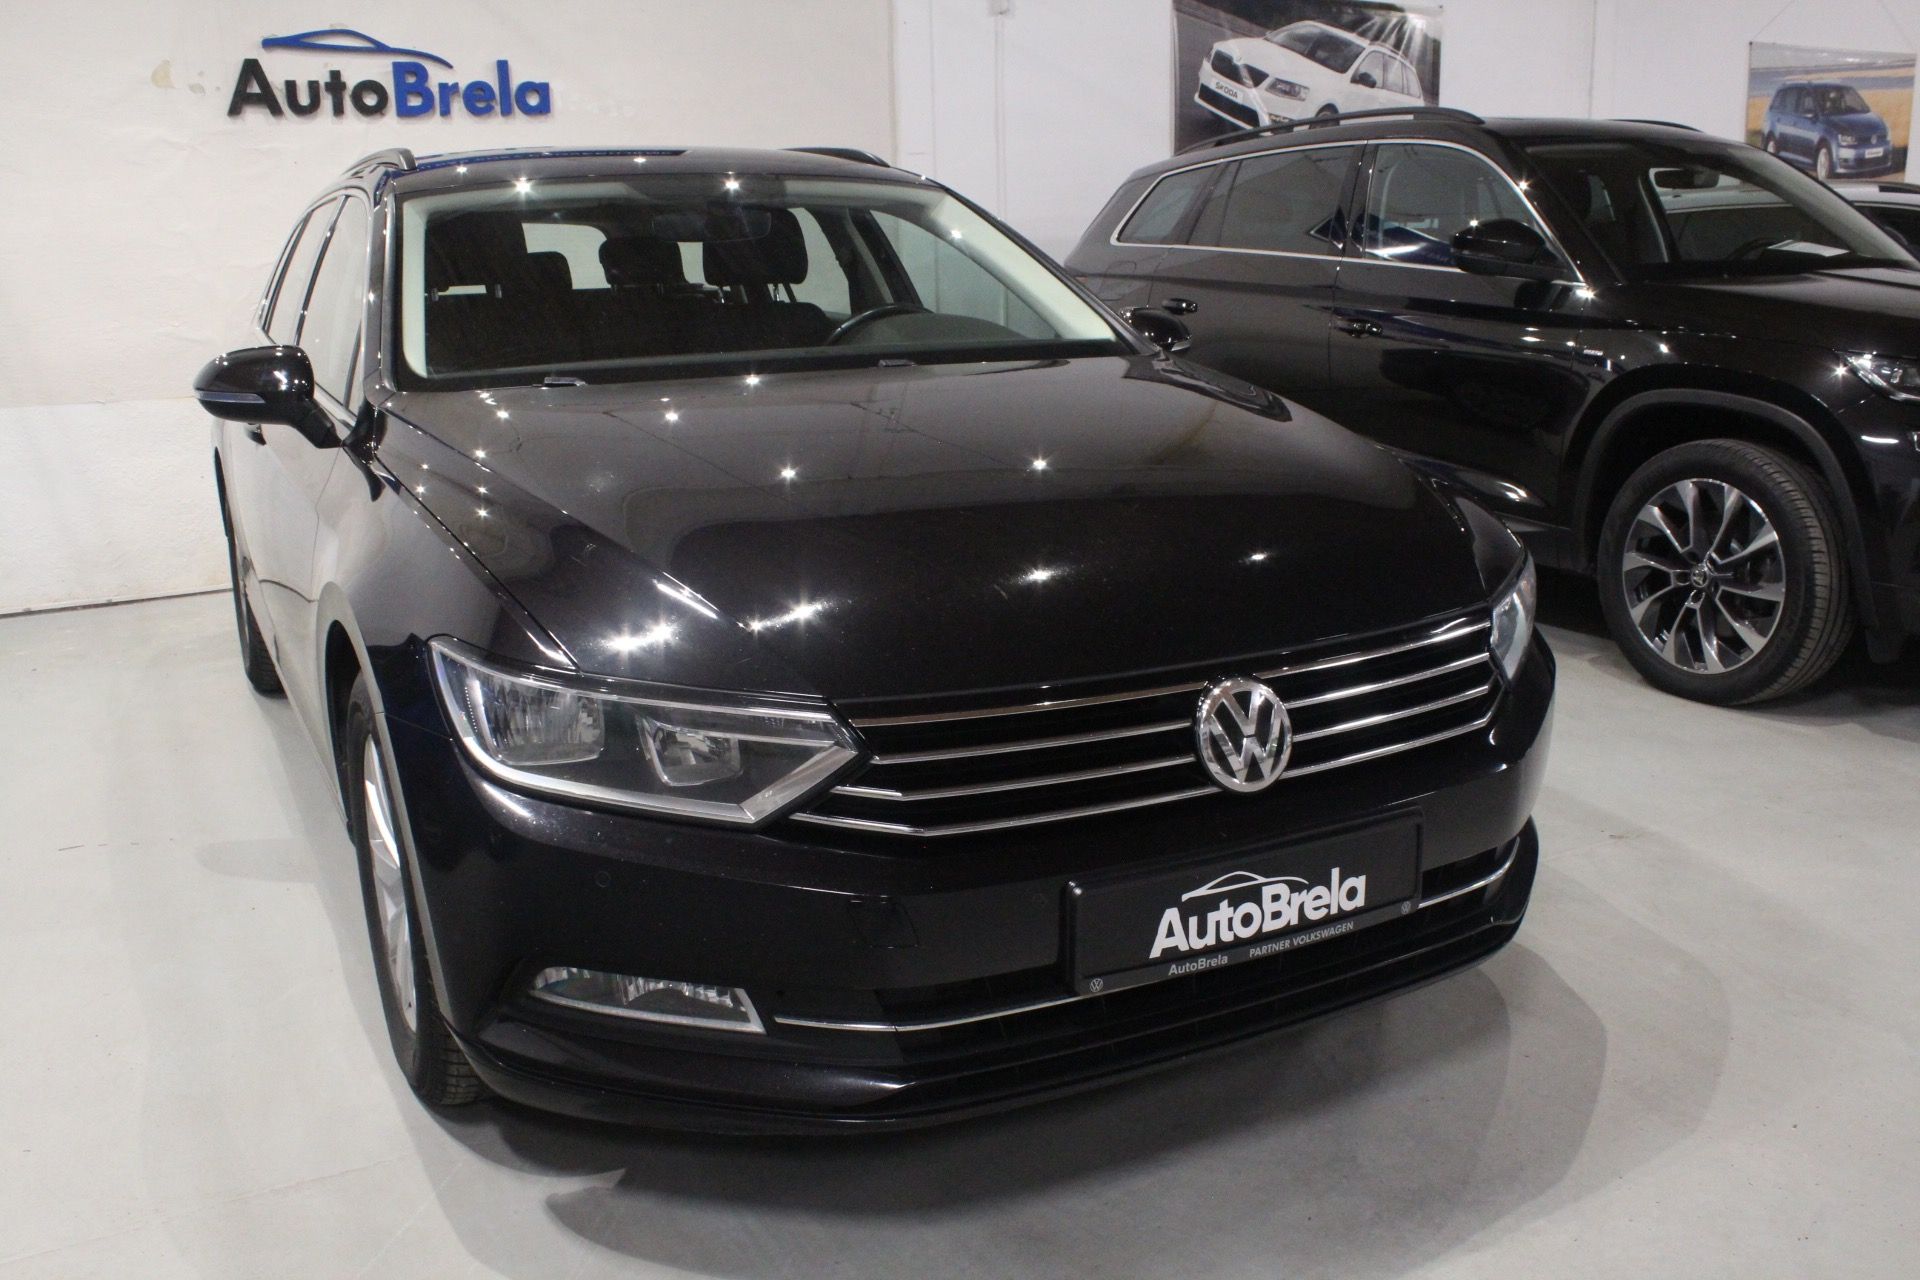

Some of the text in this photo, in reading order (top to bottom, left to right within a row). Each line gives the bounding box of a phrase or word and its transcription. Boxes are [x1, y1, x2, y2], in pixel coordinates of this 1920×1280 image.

[227, 58, 551, 118] AutoBrela
[1149, 866, 1367, 959] AutoBrela
[1168, 921, 1355, 976] AutoBrela PARTNER VOLKSWAGEN
